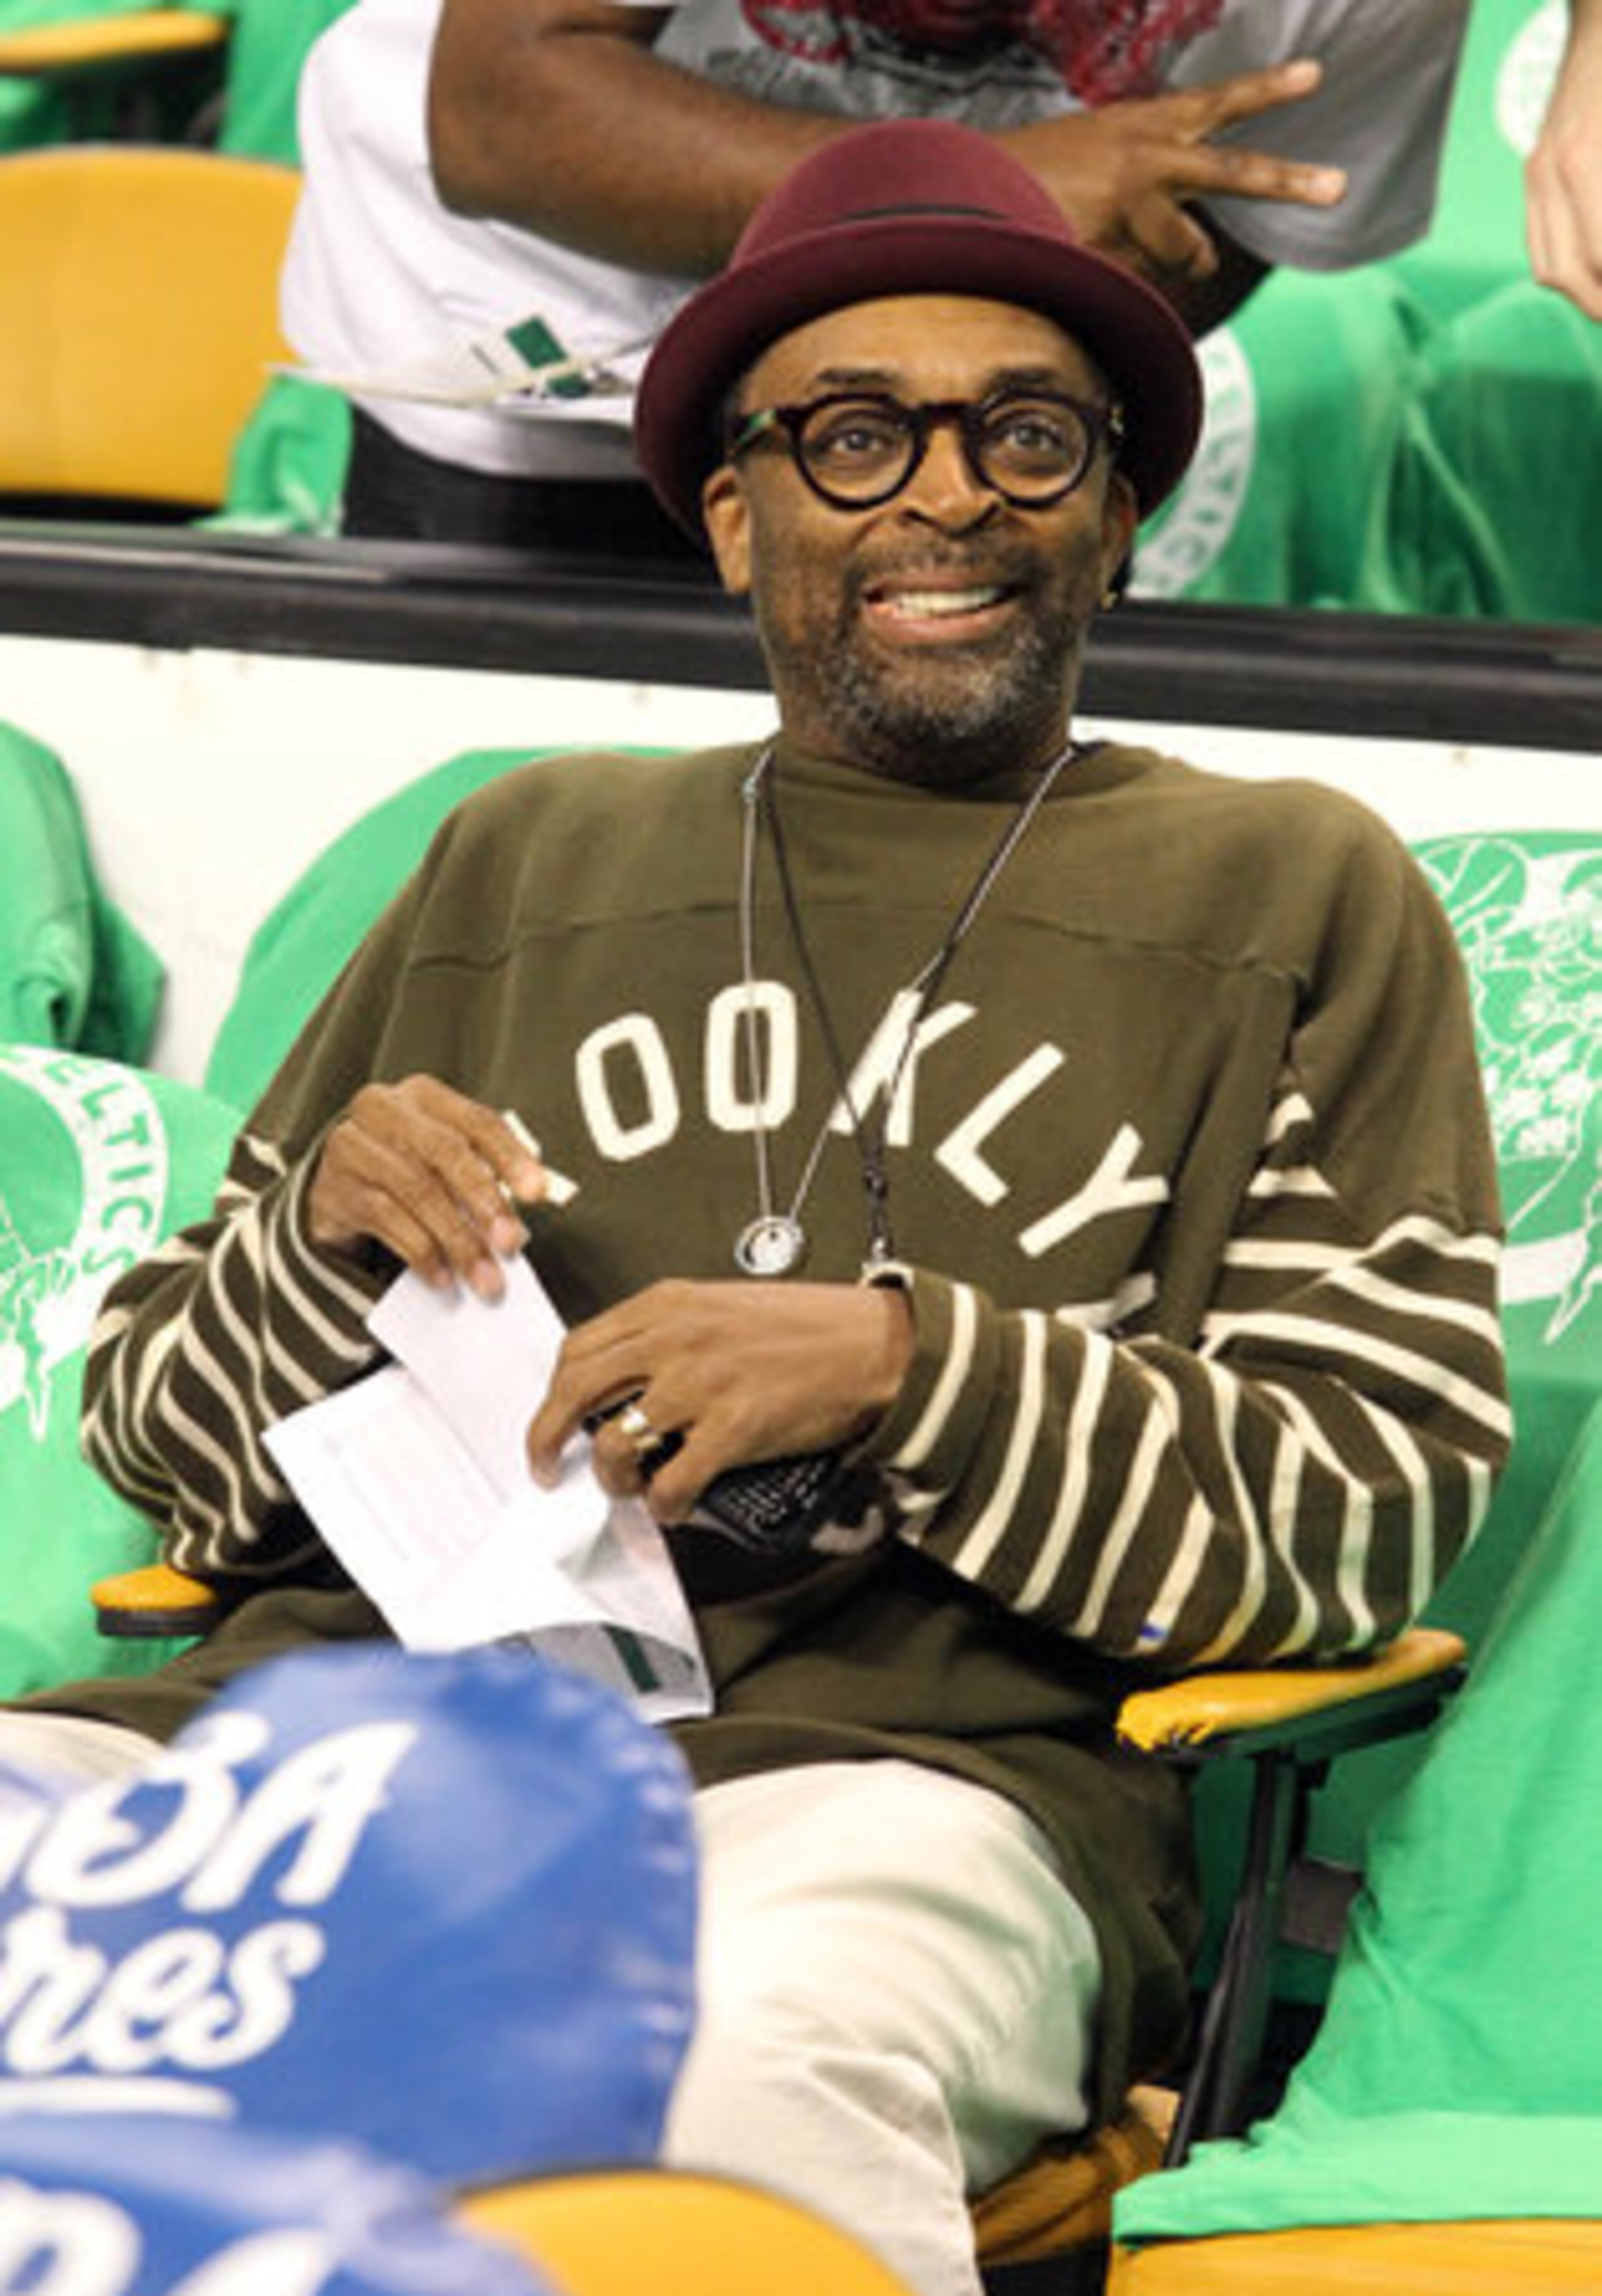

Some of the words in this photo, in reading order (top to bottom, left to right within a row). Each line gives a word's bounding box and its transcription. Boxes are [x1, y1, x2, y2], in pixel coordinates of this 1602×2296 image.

[0, 1045, 154, 1273] ELTICS
[500, 980, 1170, 1332] OOKLY
[0, 1908, 326, 2072] res
